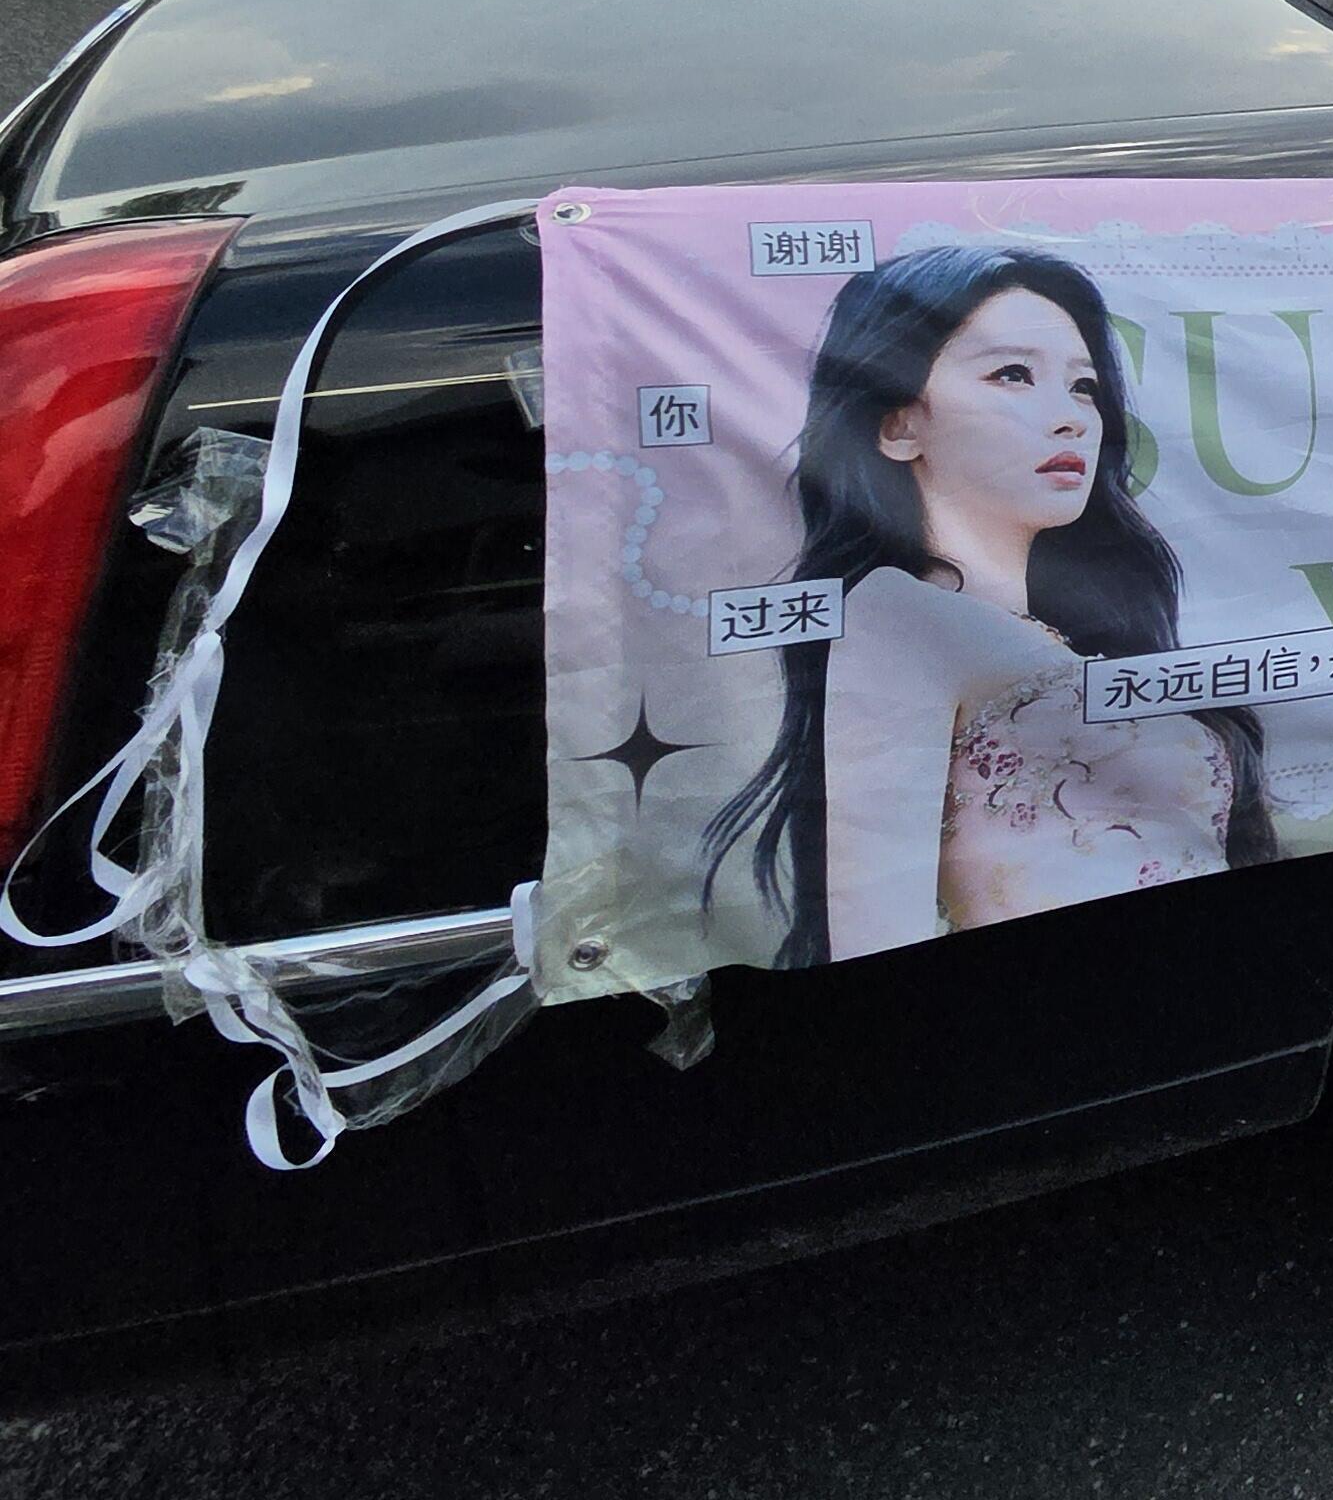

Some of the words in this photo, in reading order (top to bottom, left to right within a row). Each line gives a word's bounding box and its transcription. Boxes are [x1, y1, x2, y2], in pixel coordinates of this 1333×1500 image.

[760, 229, 862, 268] 谢谢
[648, 393, 700, 439] 你
[720, 592, 831, 642] 过来
